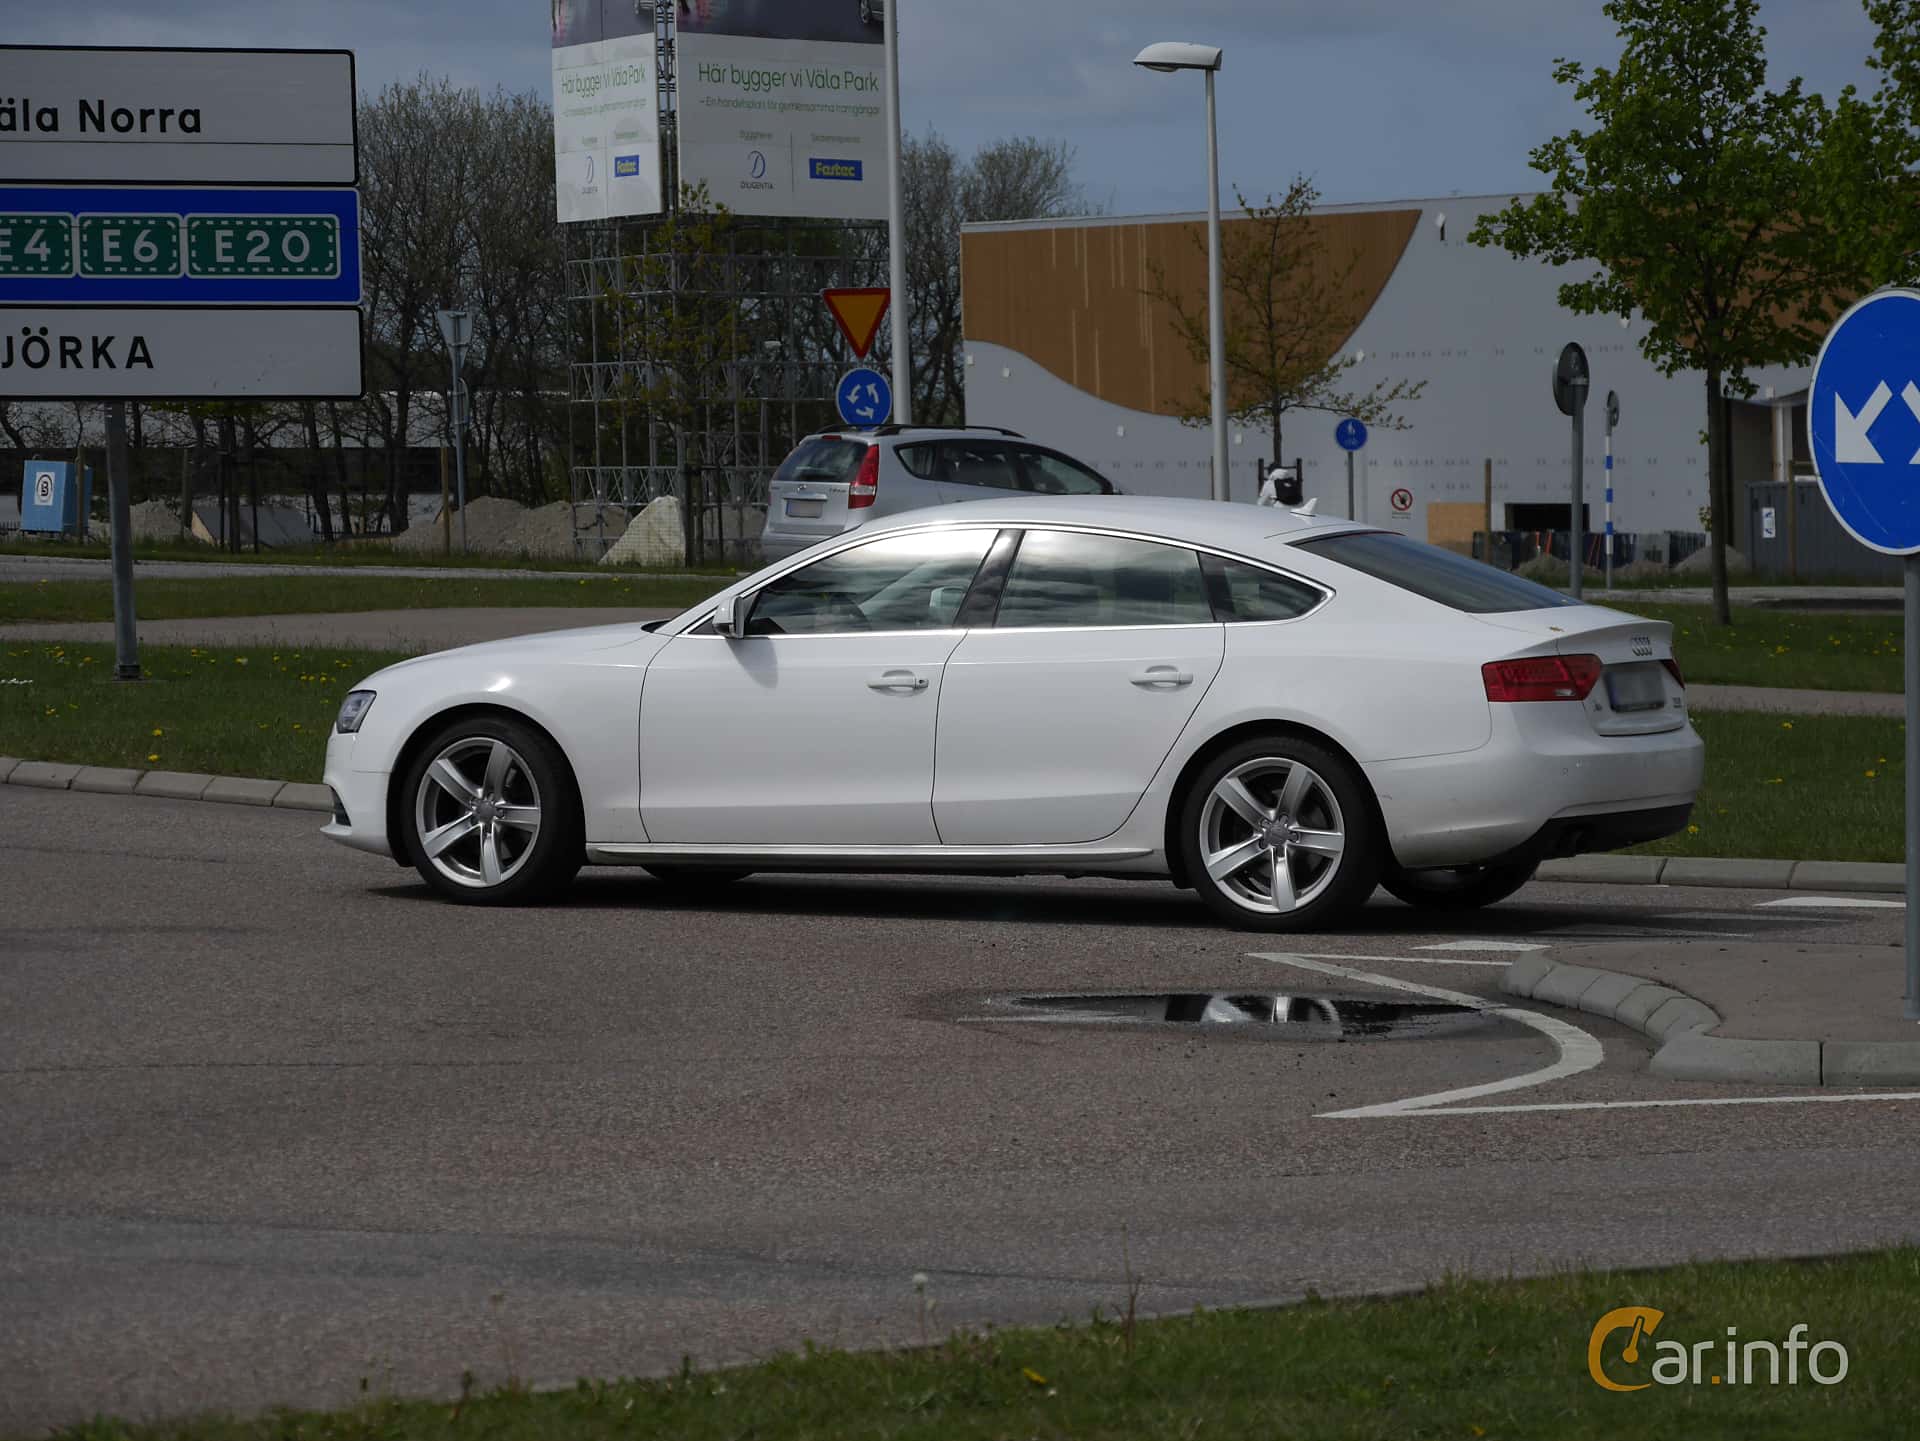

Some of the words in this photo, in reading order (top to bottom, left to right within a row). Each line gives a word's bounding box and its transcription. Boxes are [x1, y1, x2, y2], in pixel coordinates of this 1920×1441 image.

[698, 63, 727, 84] Här
[731, 64, 786, 92] bygger
[790, 71, 802, 88] vi
[805, 69, 840, 90] Väla
[844, 71, 880, 92] Park
[79, 99, 201, 133] Norra
[0, 229, 51, 262] E4
[103, 229, 158, 262] E6
[215, 230, 310, 263] E20
[1, 326, 154, 369] JÖRKA
